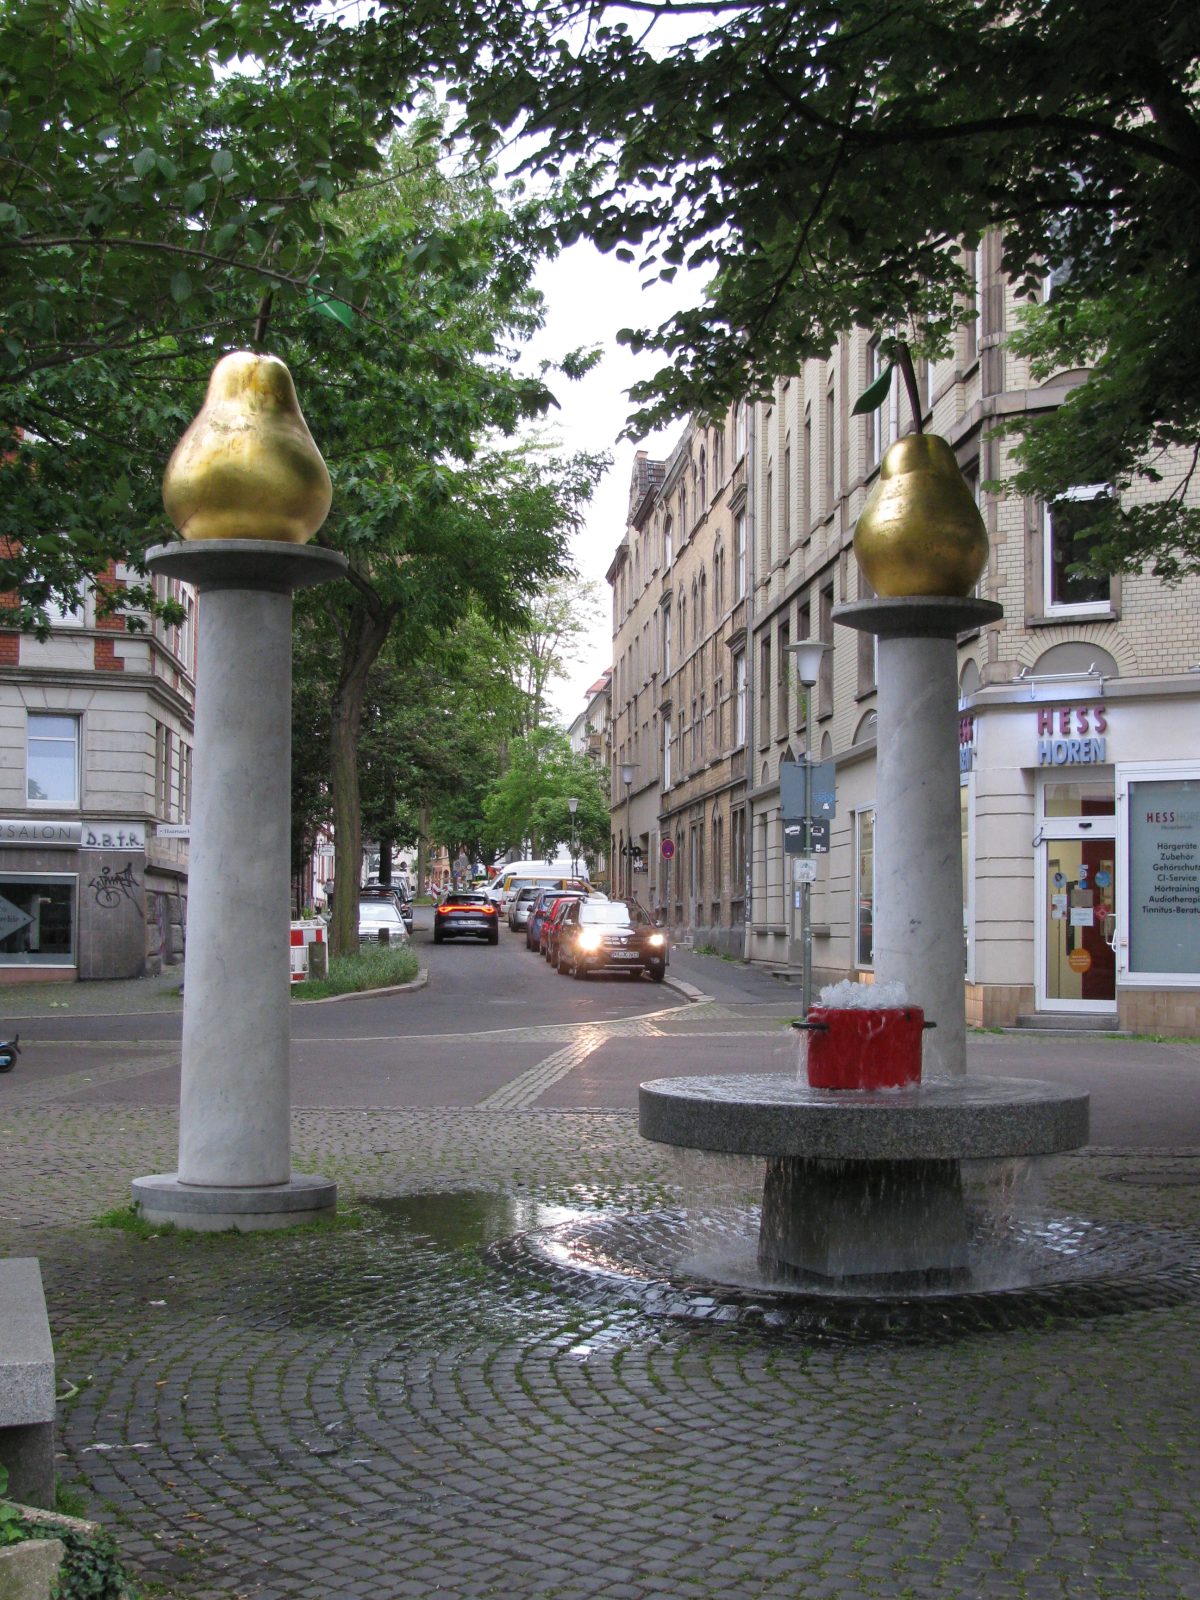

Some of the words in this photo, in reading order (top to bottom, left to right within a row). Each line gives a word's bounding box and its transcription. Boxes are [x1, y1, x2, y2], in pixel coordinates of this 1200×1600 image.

[1038, 705, 1107, 736] HESS
[1146, 811, 1175, 823] HESS
[1156, 842, 1198, 852] Hörgeräte
[1157, 873, 1198, 882] CI-Service
[1148, 895, 1200, 904] Audiotherapi
